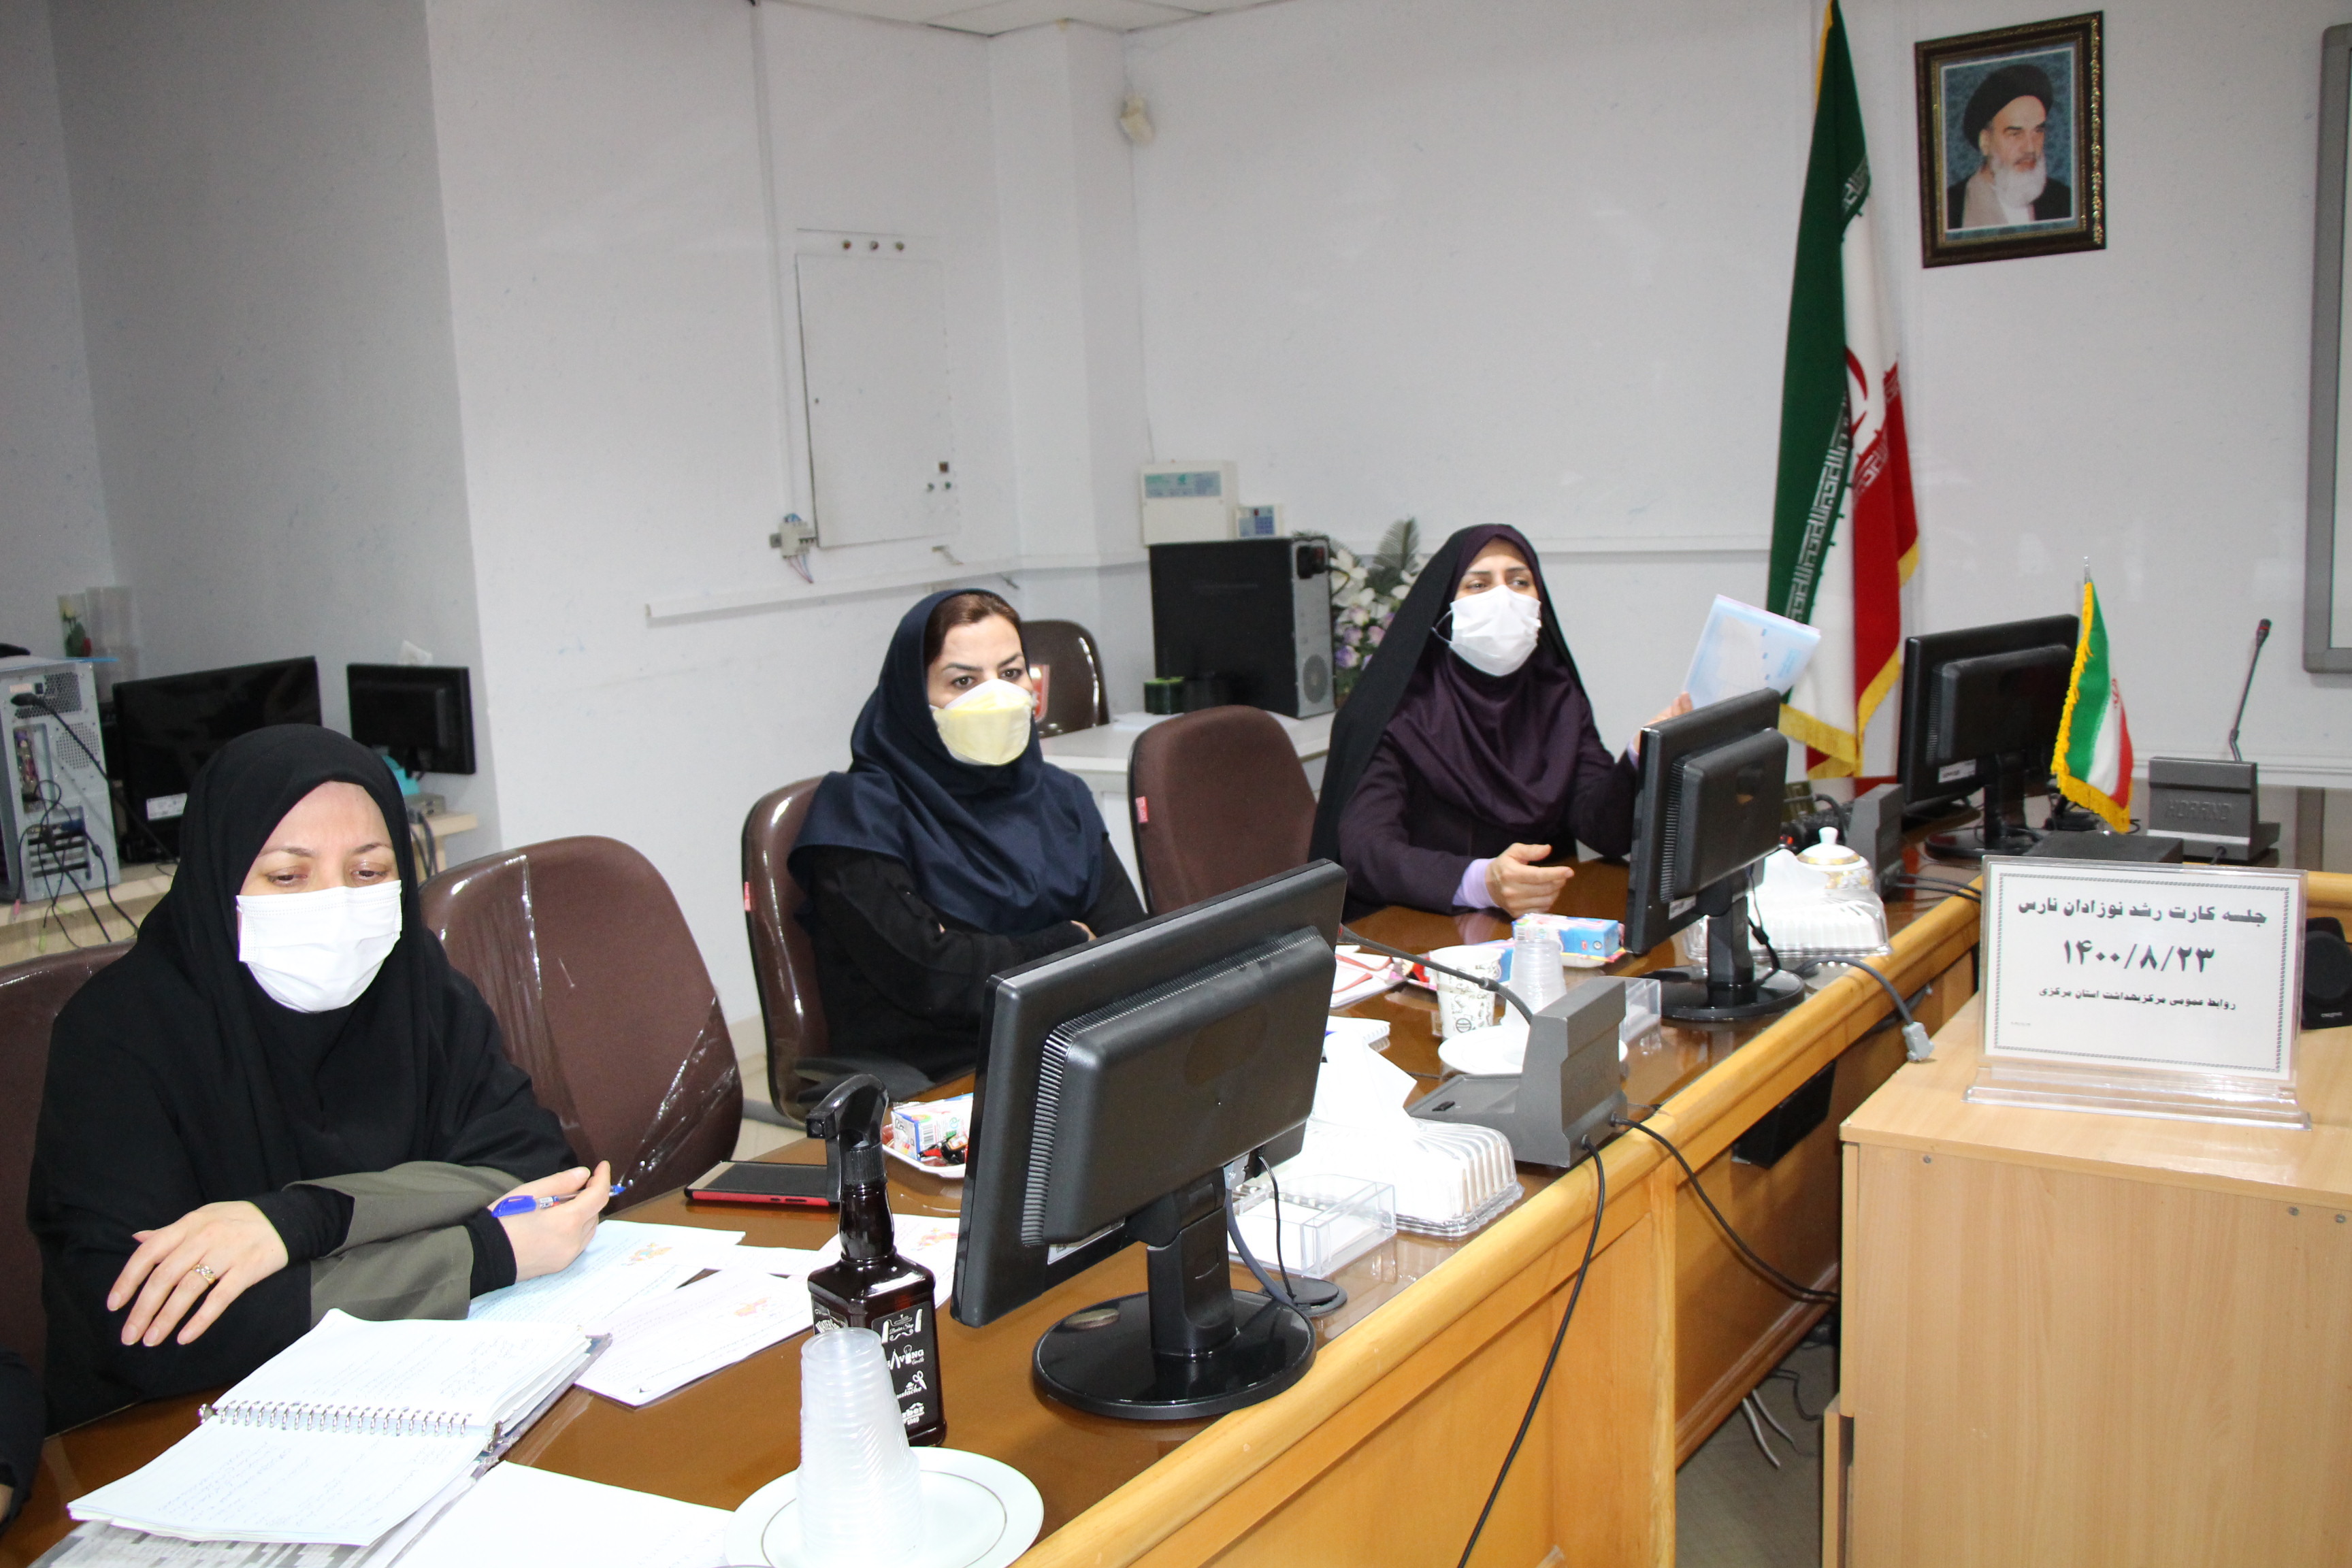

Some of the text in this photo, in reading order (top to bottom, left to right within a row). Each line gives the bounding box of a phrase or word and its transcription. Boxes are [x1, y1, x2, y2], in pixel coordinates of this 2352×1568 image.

[2019, 897, 2267, 928] جلسه کارت رشد نوزادان نارس
[2039, 987, 2072, 998] مرکزی
[2075, 990, 2099, 999] استان
[2169, 998, 2204, 1007] عمومی
[2206, 998, 2236, 1010] روابط
